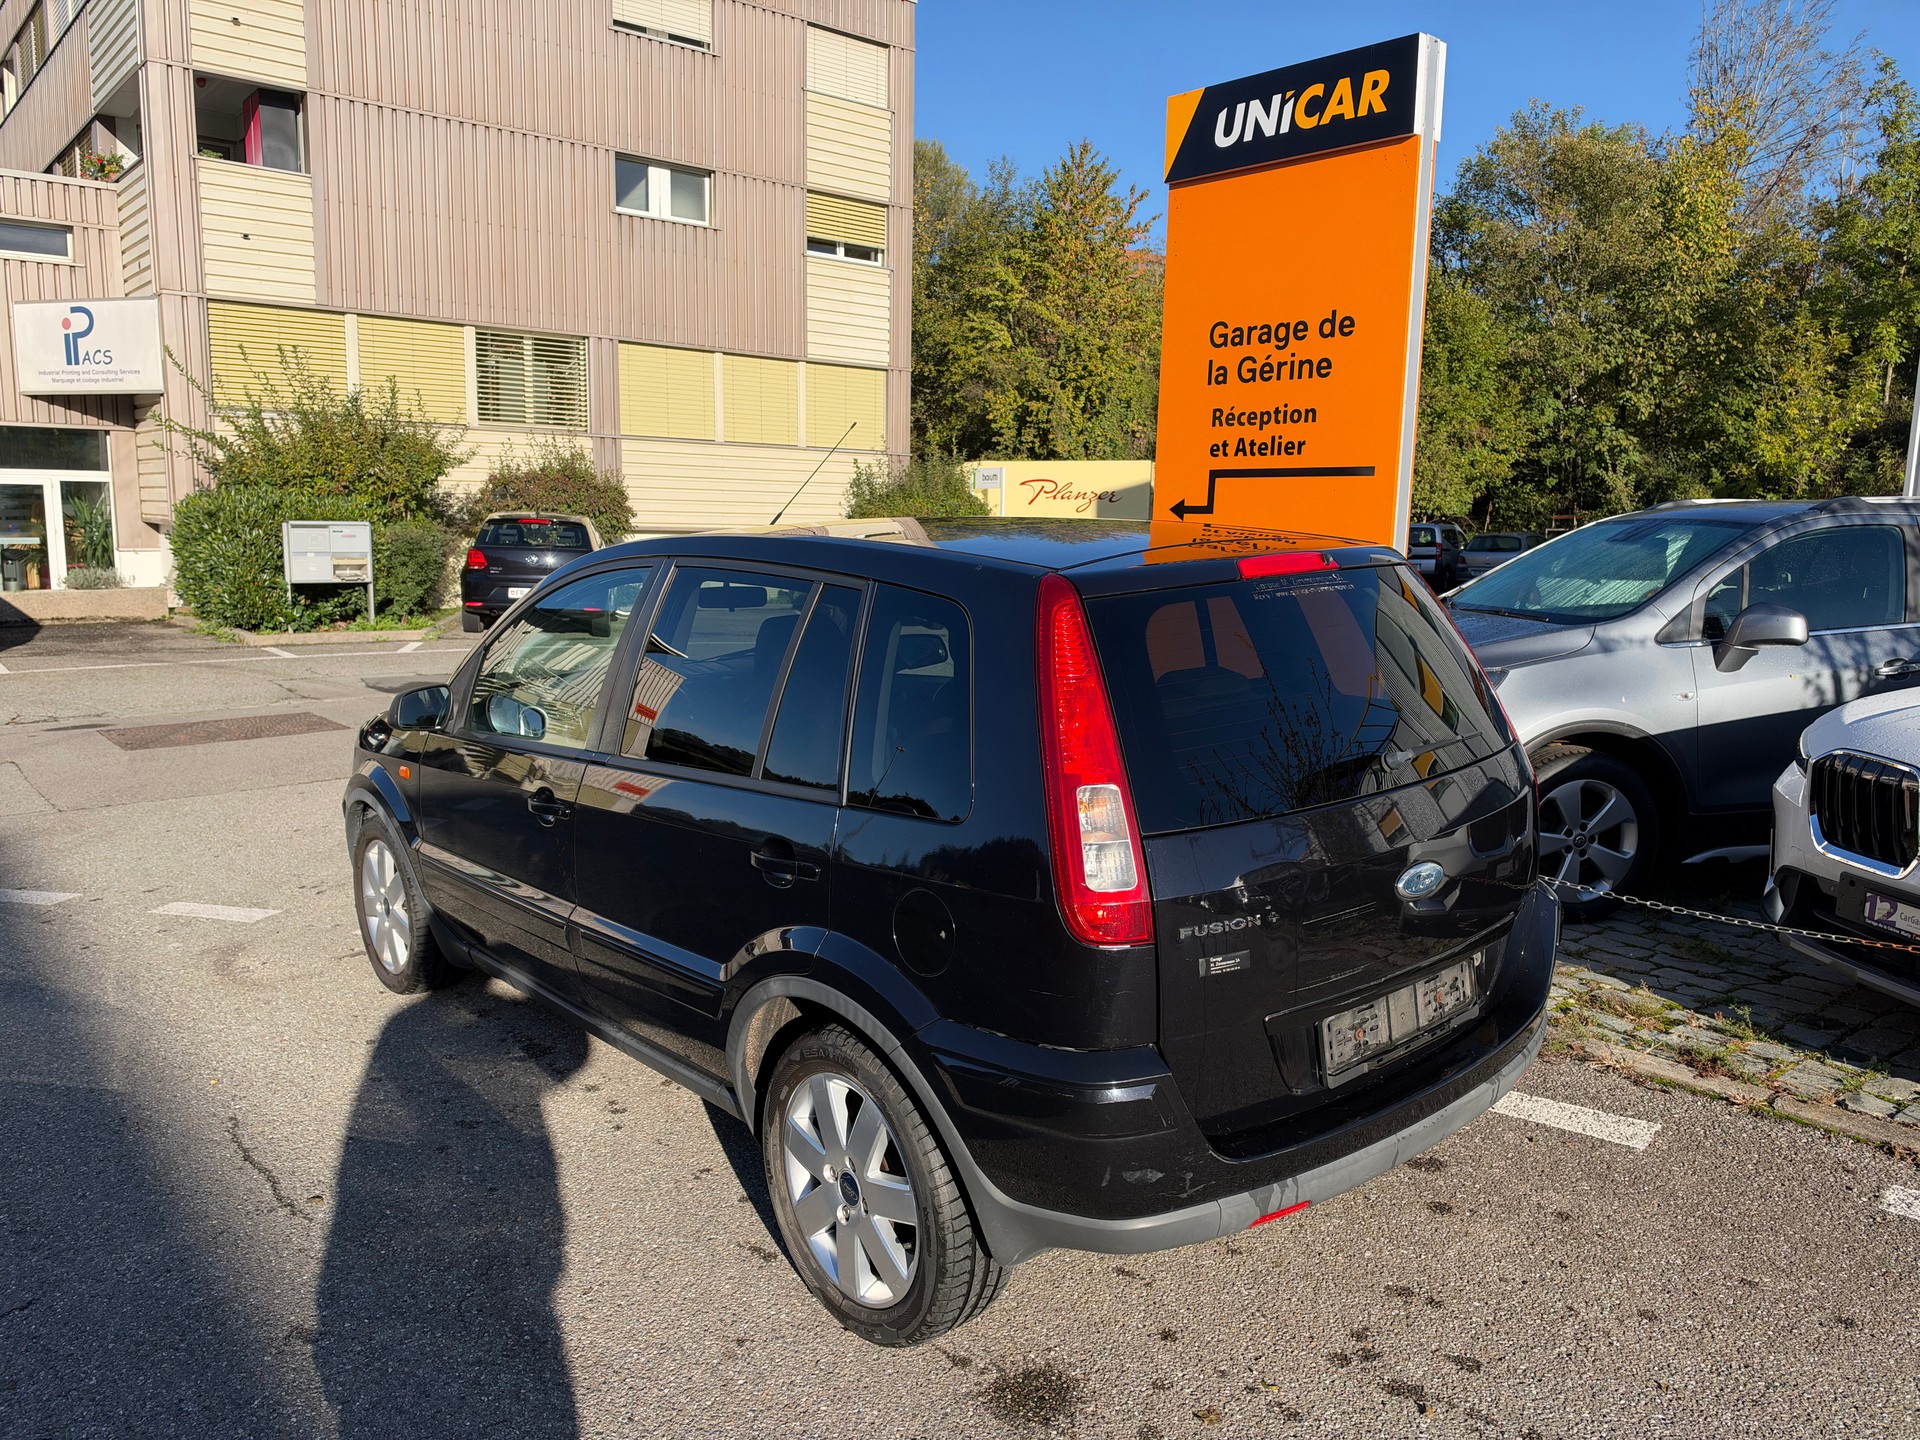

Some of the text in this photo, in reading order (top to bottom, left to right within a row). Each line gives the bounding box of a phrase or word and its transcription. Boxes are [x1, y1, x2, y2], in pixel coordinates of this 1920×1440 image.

[1209, 309, 1356, 351] Garage de
[92, 369, 118, 377] Consulting
[1207, 352, 1333, 386] la Gérine
[1211, 403, 1317, 431] Réception
[1209, 435, 1306, 458] et Atelier
[1019, 479, 1123, 513] Planzer
[1179, 914, 1261, 939] FUSION
[1900, 911, 1920, 926] CarGa
